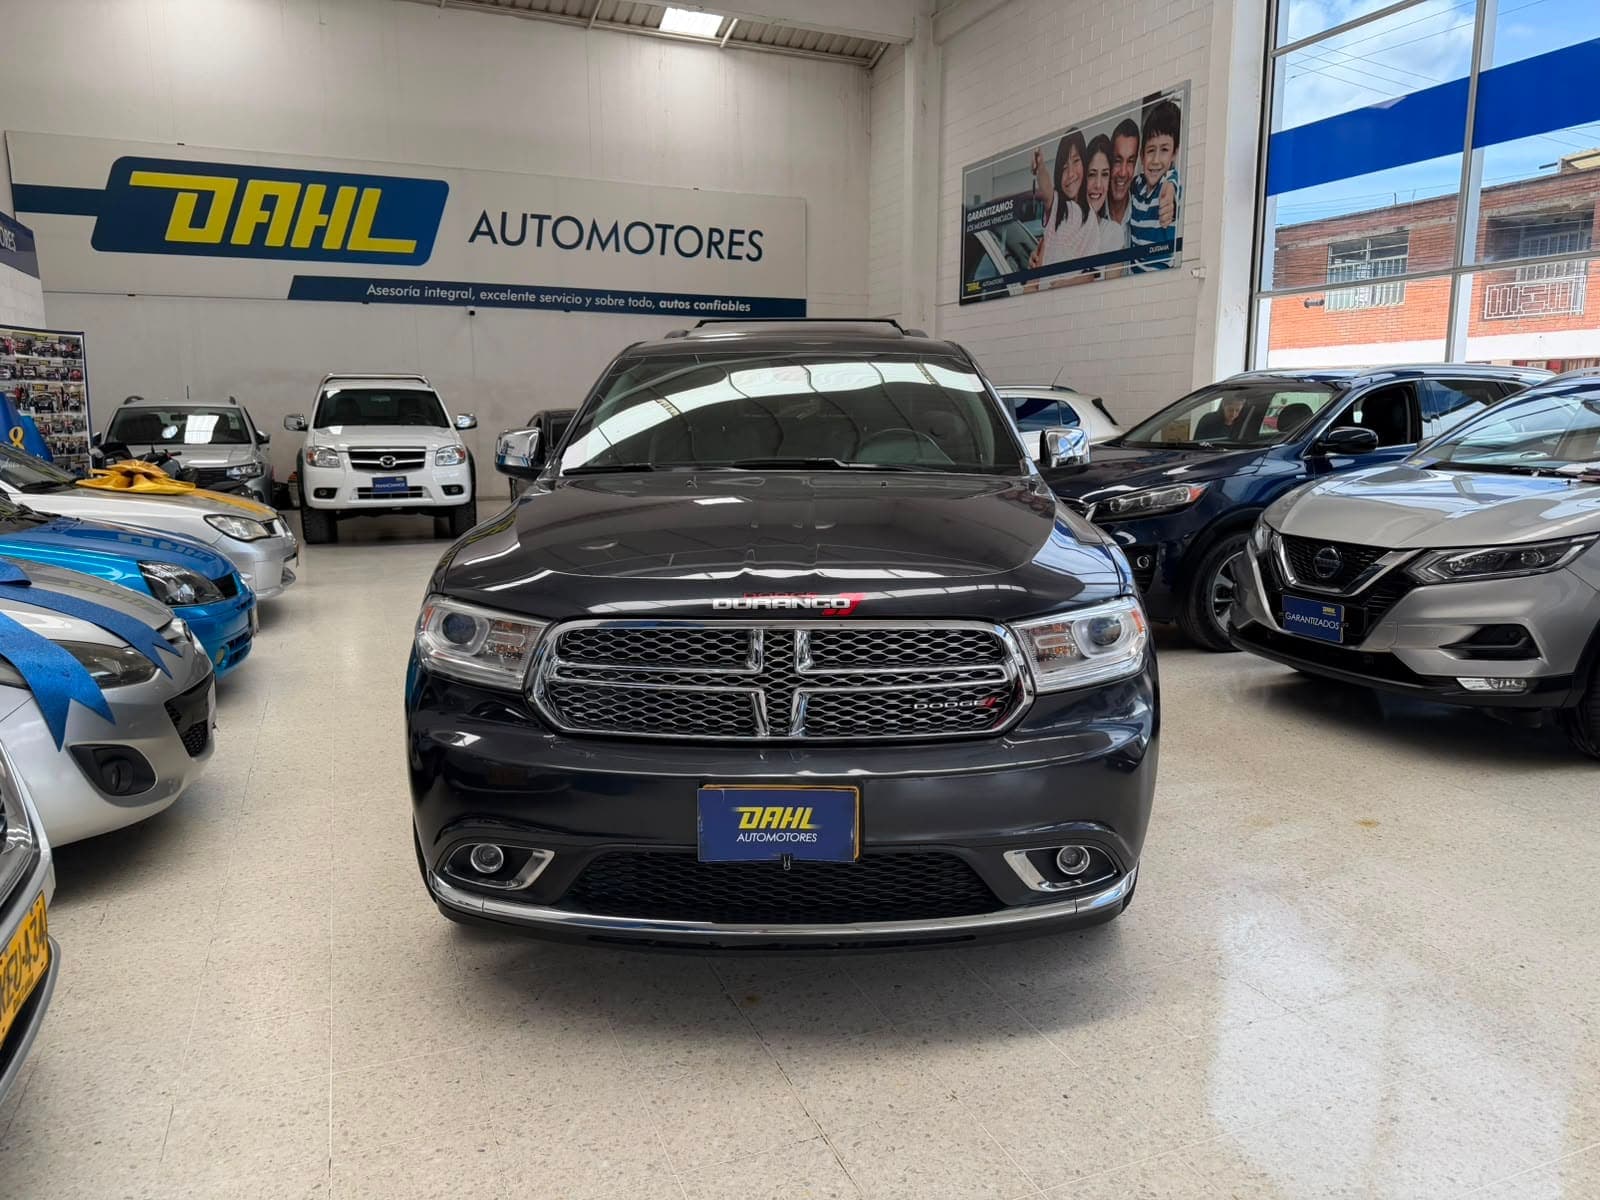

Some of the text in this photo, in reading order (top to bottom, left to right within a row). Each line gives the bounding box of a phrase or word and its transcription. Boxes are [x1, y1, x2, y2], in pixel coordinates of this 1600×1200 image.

[129, 170, 418, 254] DAHL
[468, 208, 764, 262] AUTOMOTORES
[366, 284, 751, 312] Asesoría integral, excelente servicio y sobre todo, autos confiables
[712, 597, 851, 609] DURANGO
[1285, 611, 1340, 630] GARANTIZADOS
[734, 806, 821, 830] DAHL
[736, 832, 818, 842] AUTOMOTORES
